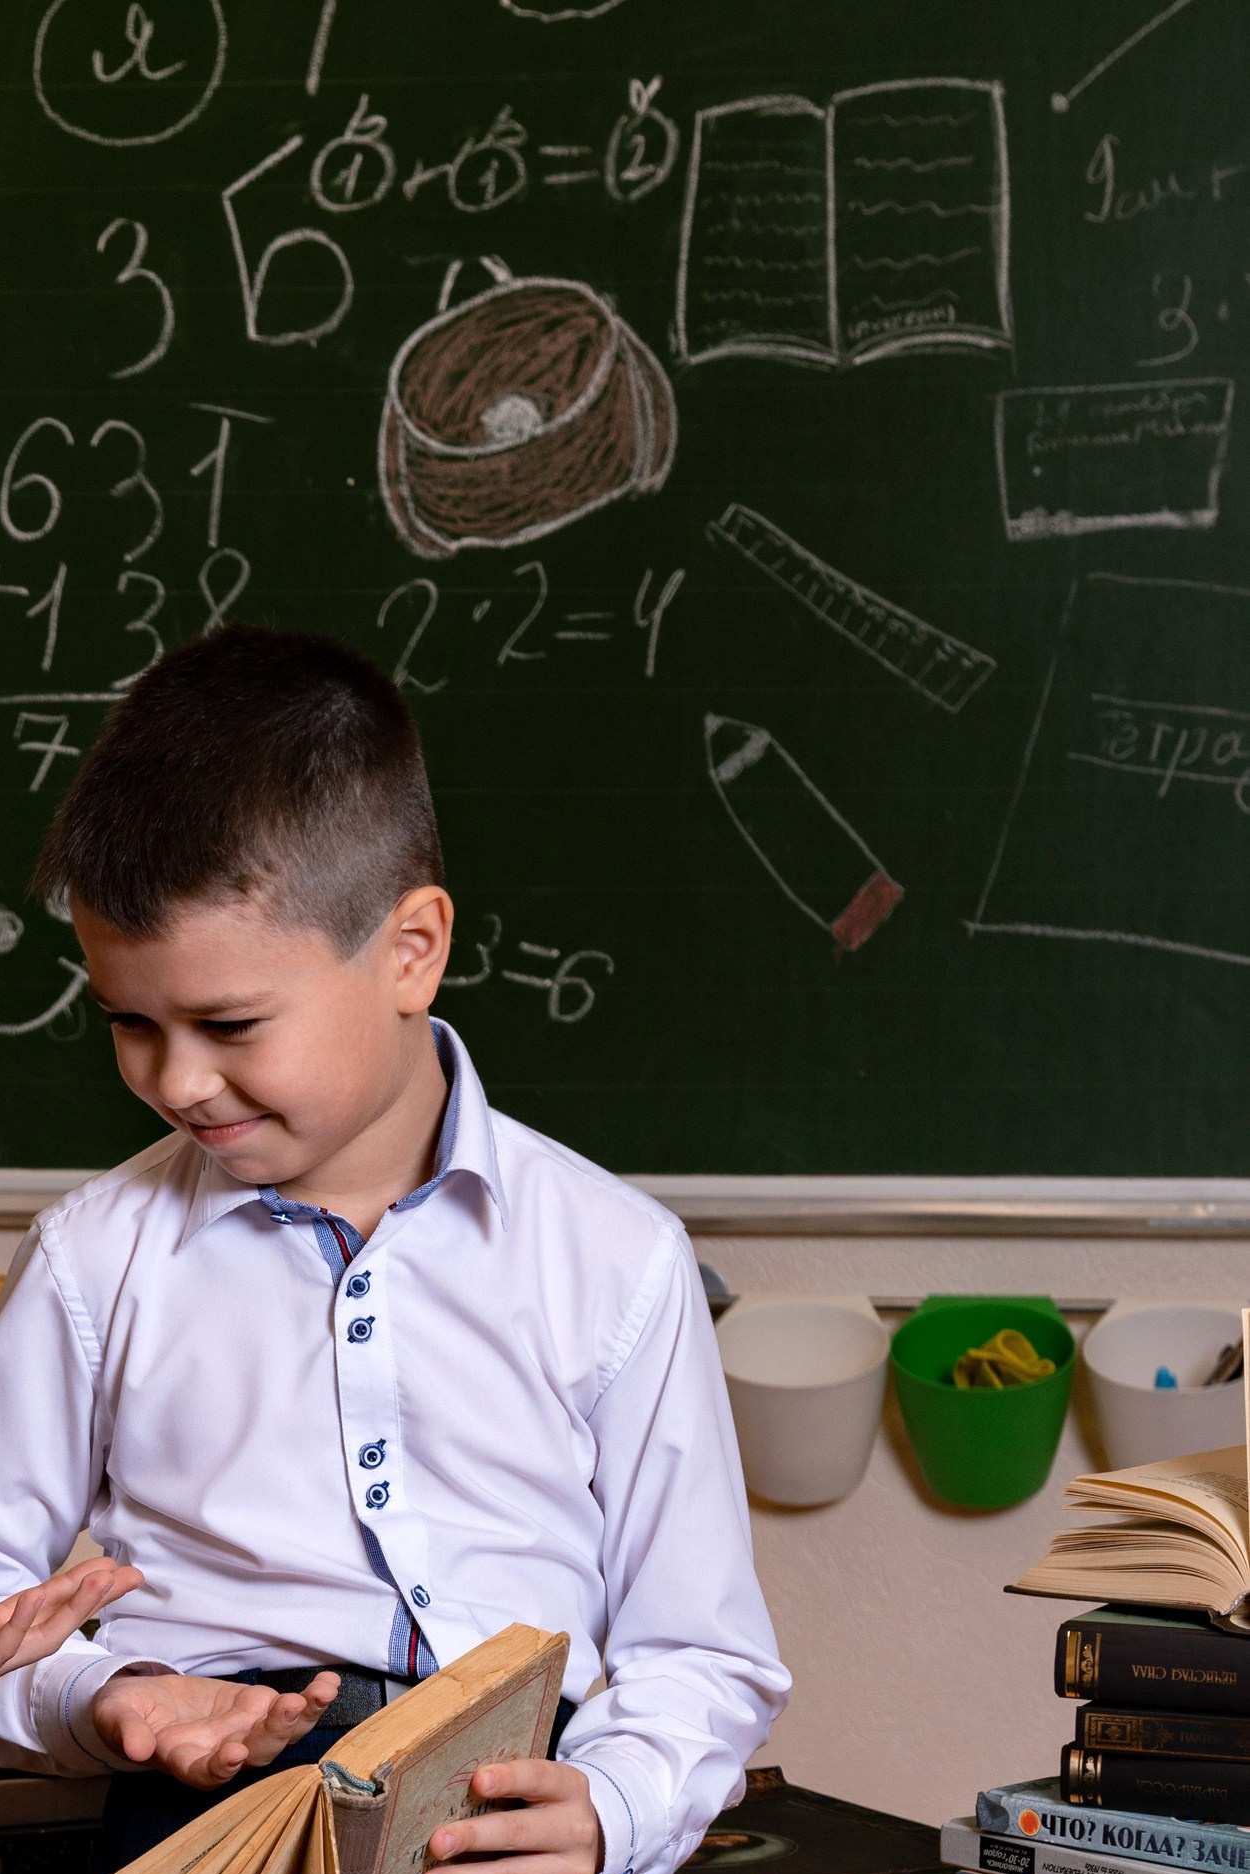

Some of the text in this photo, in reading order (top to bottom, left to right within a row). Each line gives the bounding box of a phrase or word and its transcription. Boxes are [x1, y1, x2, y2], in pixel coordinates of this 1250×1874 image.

[1131, 1664, 1167, 1680] СИЛА
[1041, 1813, 1097, 1842] ЧТО?
[1102, 1823, 1186, 1858] КОГДА?
